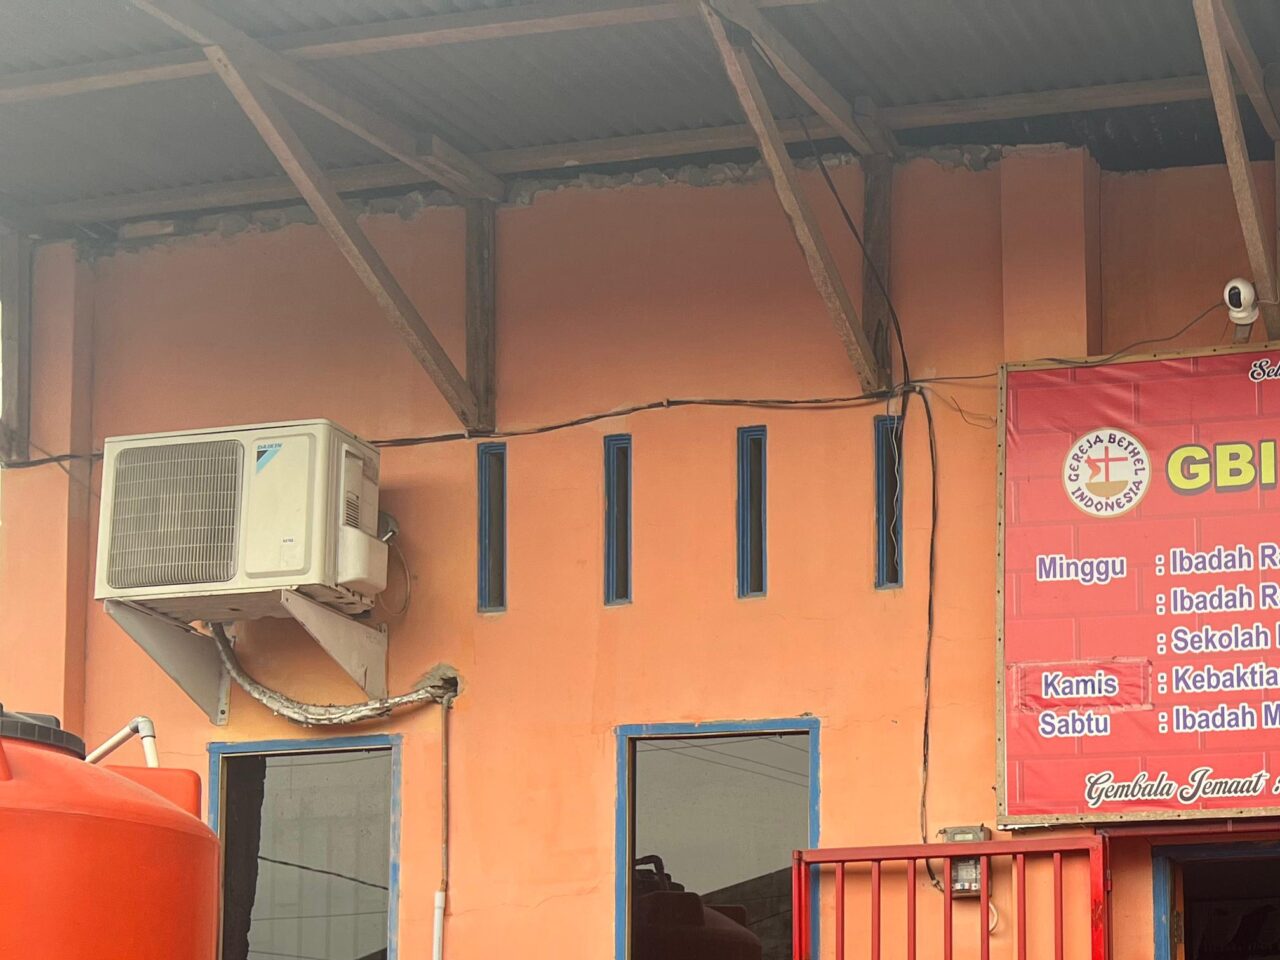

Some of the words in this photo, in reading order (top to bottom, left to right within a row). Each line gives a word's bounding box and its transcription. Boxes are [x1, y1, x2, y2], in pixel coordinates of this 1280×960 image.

[1068, 434, 1104, 482] GEREJA
[1108, 433, 1146, 476] BETHEL
[1166, 440, 1277, 492] GBI
[1071, 479, 1143, 512] INDONESIA
[1038, 556, 1125, 582] Minggu
[1171, 547, 1252, 574] Ibadah
[1171, 587, 1252, 613] Ibadah
[1173, 625, 1269, 652] Sekolah
[1043, 672, 1118, 697] Kamis
[1039, 711, 1110, 737] Sabtu
[1174, 706, 1256, 731] Ibadah
[1086, 771, 1175, 807] Gembala
[1179, 766, 1268, 805] Jemaat
